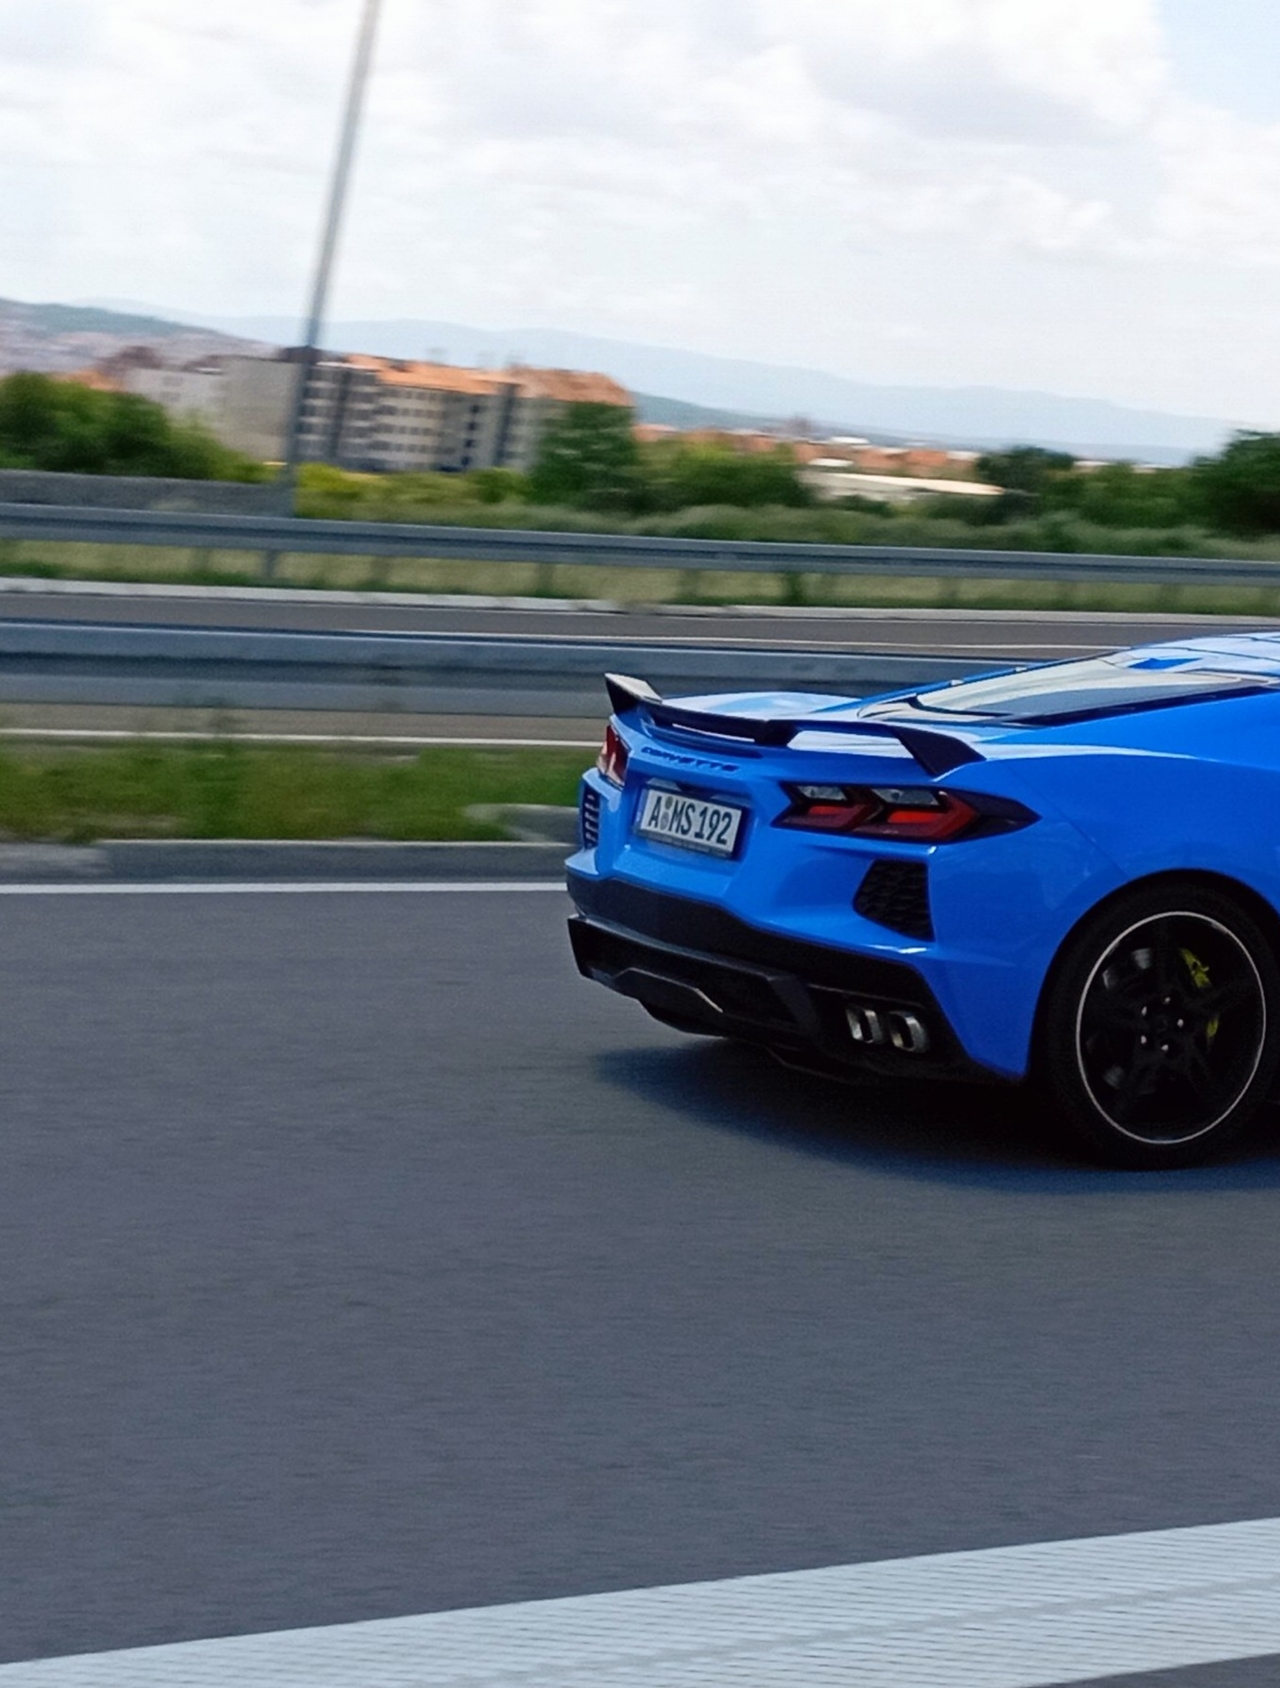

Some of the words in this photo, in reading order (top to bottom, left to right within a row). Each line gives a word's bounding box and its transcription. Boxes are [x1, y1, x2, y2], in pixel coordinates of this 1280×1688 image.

[647, 795, 662, 828] A
[668, 799, 696, 836] MS
[694, 806, 733, 846] 192
